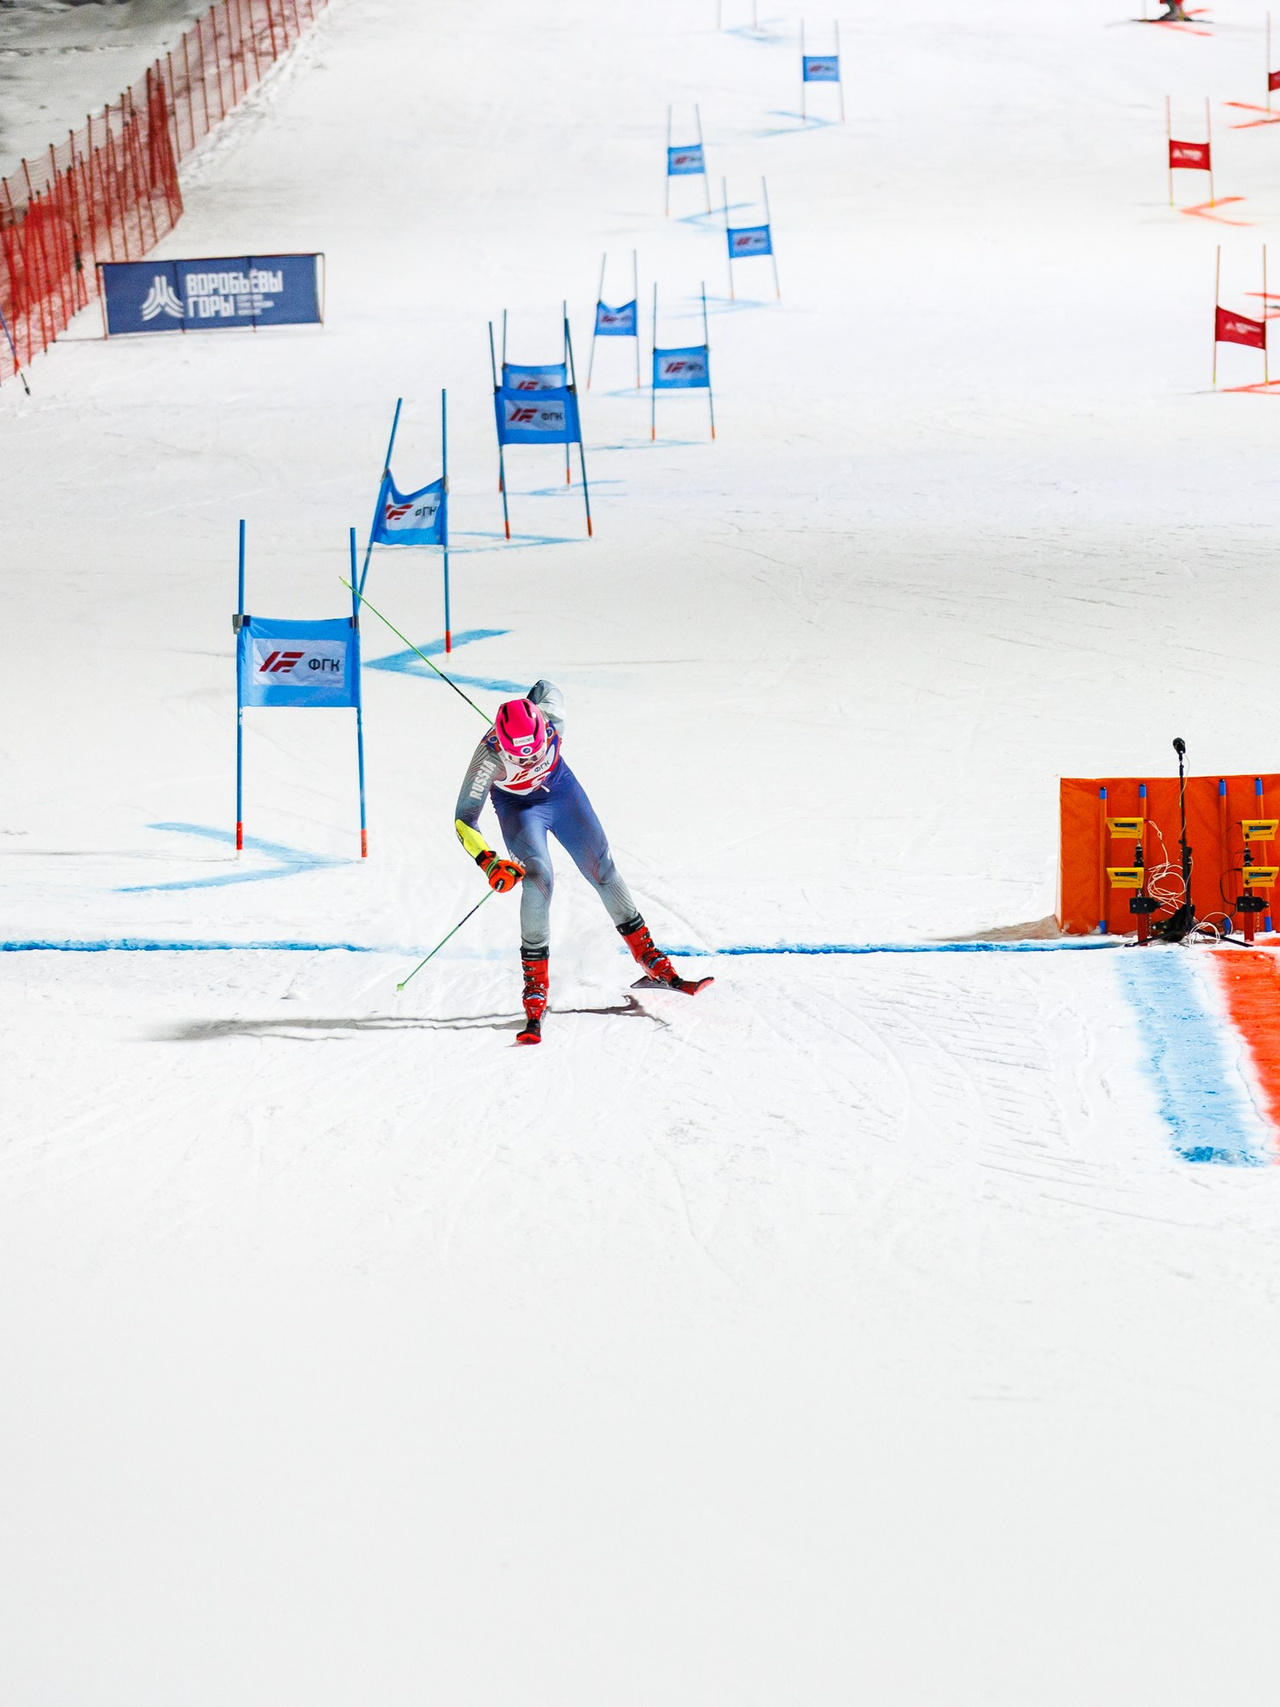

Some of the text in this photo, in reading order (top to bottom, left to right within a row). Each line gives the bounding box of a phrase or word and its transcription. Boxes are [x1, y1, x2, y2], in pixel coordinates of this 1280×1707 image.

[186, 269, 284, 296] ВОРОБЬЁВЫ
[187, 296, 235, 318] ГОРЫ
[308, 658, 340, 672] ФГК
[534, 760, 550, 773] ФГК
[469, 760, 497, 800] RUSSIA
